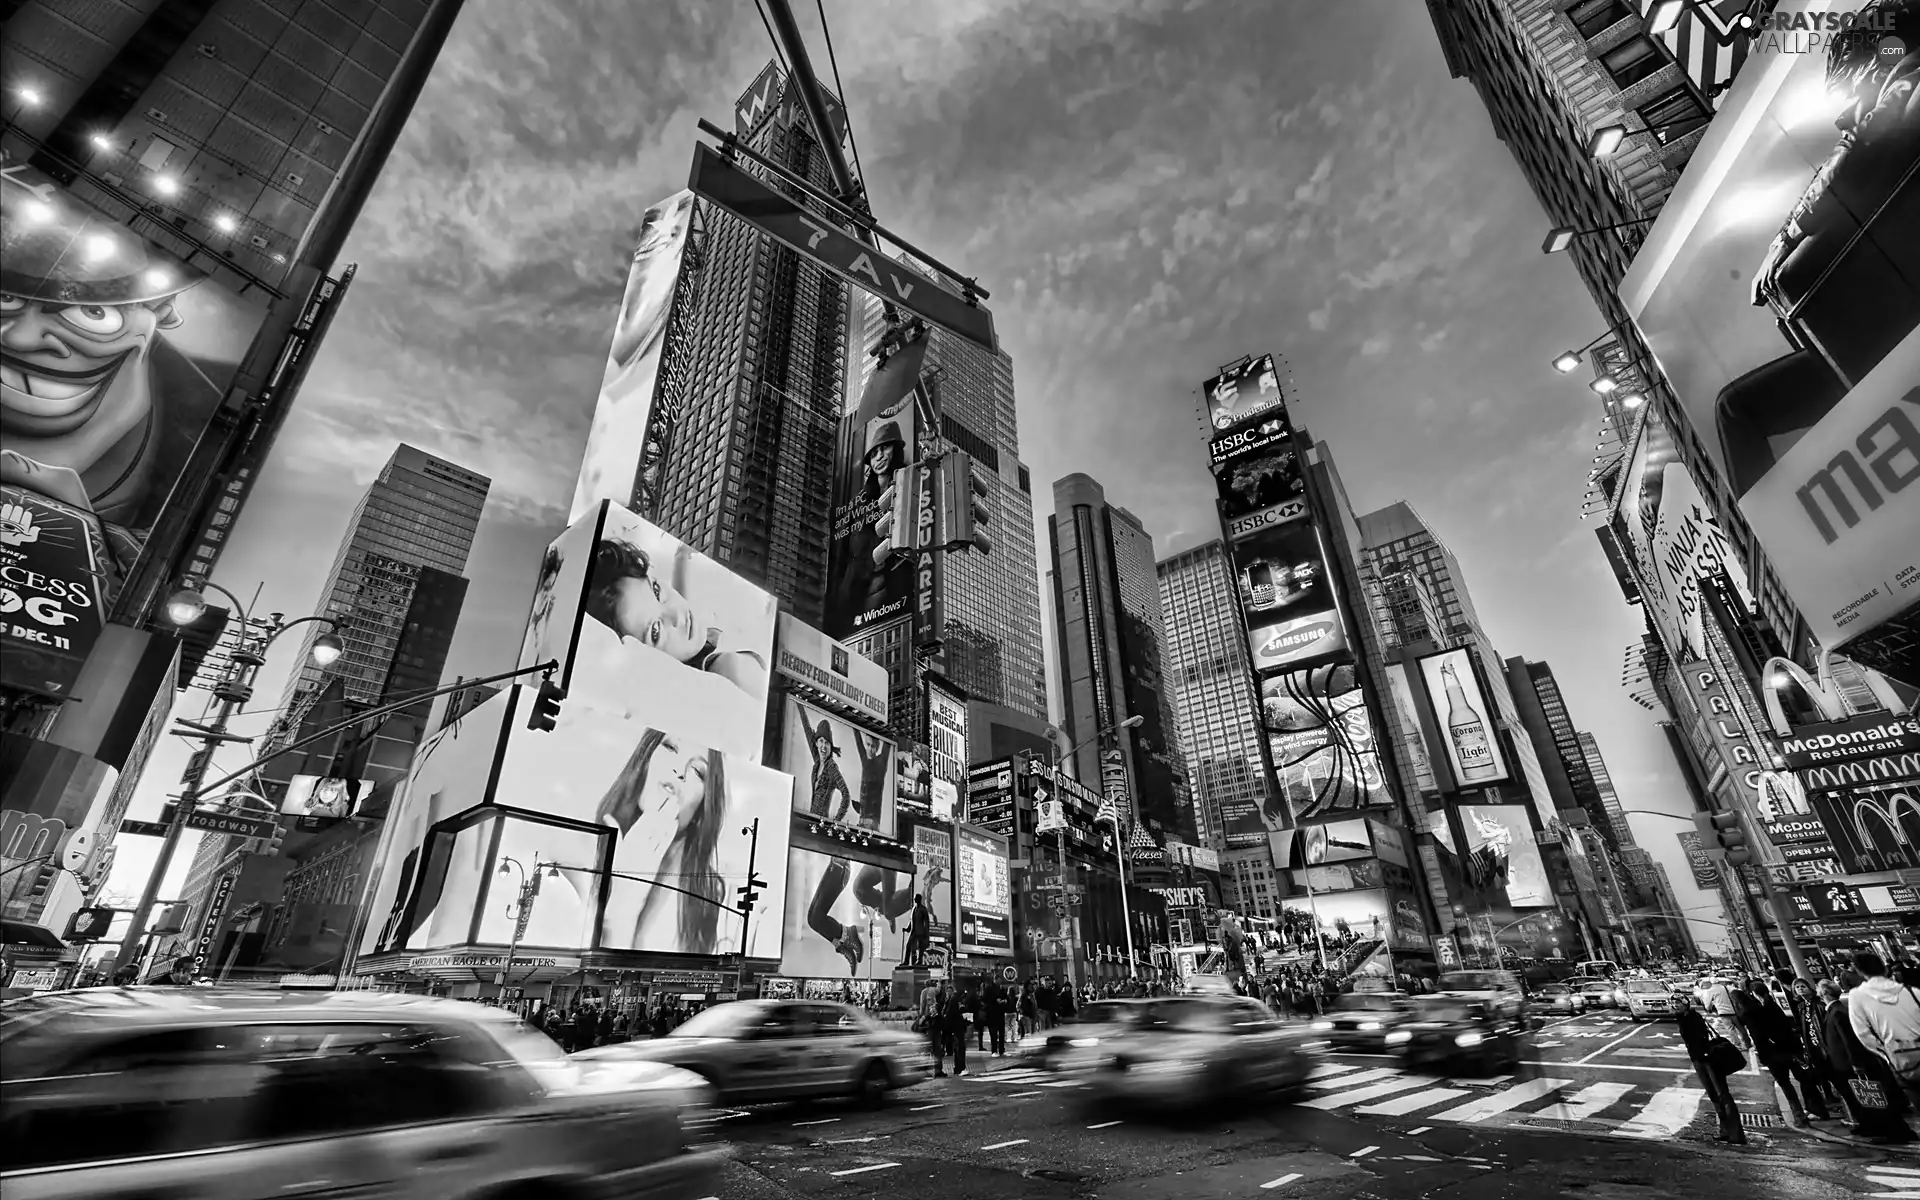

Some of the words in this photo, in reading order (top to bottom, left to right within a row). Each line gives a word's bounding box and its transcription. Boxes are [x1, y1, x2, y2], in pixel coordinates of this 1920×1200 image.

[799, 216, 828, 249] 7
[849, 252, 914, 300] AV
[1234, 394, 1282, 422] Prudential
[1211, 428, 1256, 455] HSBC
[1213, 453, 1227, 463] The
[1228, 441, 1252, 458] world's
[1252, 436, 1269, 449] local
[1270, 430, 1288, 442] bank
[1795, 384, 1920, 546] ma
[835, 505, 848, 518] I'm
[855, 494, 867, 507] PC
[835, 514, 850, 529] and
[851, 497, 880, 518] Windo
[834, 527, 849, 540] was
[850, 519, 864, 537] my
[1231, 510, 1277, 535] HSBC
[918, 490, 936, 614] SQUARE
[1664, 514, 1701, 584] NINJA
[1895, 564, 1917, 582] DATA
[864, 601, 900, 623] Windows
[901, 596, 908, 607] 7
[1831, 587, 1879, 622] RECORDABLE
[919, 625, 932, 635] NYC
[1836, 611, 1861, 629] MEDIA
[11, 624, 52, 645] DEC.
[53, 635, 70, 650] 11
[1268, 628, 1326, 651] SAMSUNG
[782, 650, 813, 678] READY
[813, 666, 830, 688] FOR
[830, 675, 864, 704] HOLIDAY
[864, 694, 886, 716] CHEER
[932, 710, 965, 737] MUSICAL
[939, 703, 957, 720] BEST
[933, 724, 955, 758] BILLY
[1270, 733, 1295, 746] display
[1296, 728, 1328, 740] powered
[1452, 725, 1482, 738] Corona
[1783, 719, 1920, 754] McDonald's
[1273, 744, 1282, 753] by
[1283, 740, 1301, 751] wind
[1301, 737, 1328, 748] energy
[1460, 745, 1488, 759] Light
[1810, 738, 1904, 760] Restaurant
[135, 822, 146, 833] 7
[192, 814, 259, 836] roadway
[1131, 849, 1163, 860] Reese's
[1785, 848, 1812, 857] OPEN
[1813, 845, 1827, 854] 24
[191, 880, 229, 975] SCIENTOLOG
[411, 956, 450, 967] AMERICAN
[451, 956, 487, 966] EAGLE
[489, 956, 557, 967] OUTERS
[922, 951, 945, 966] ROXY
